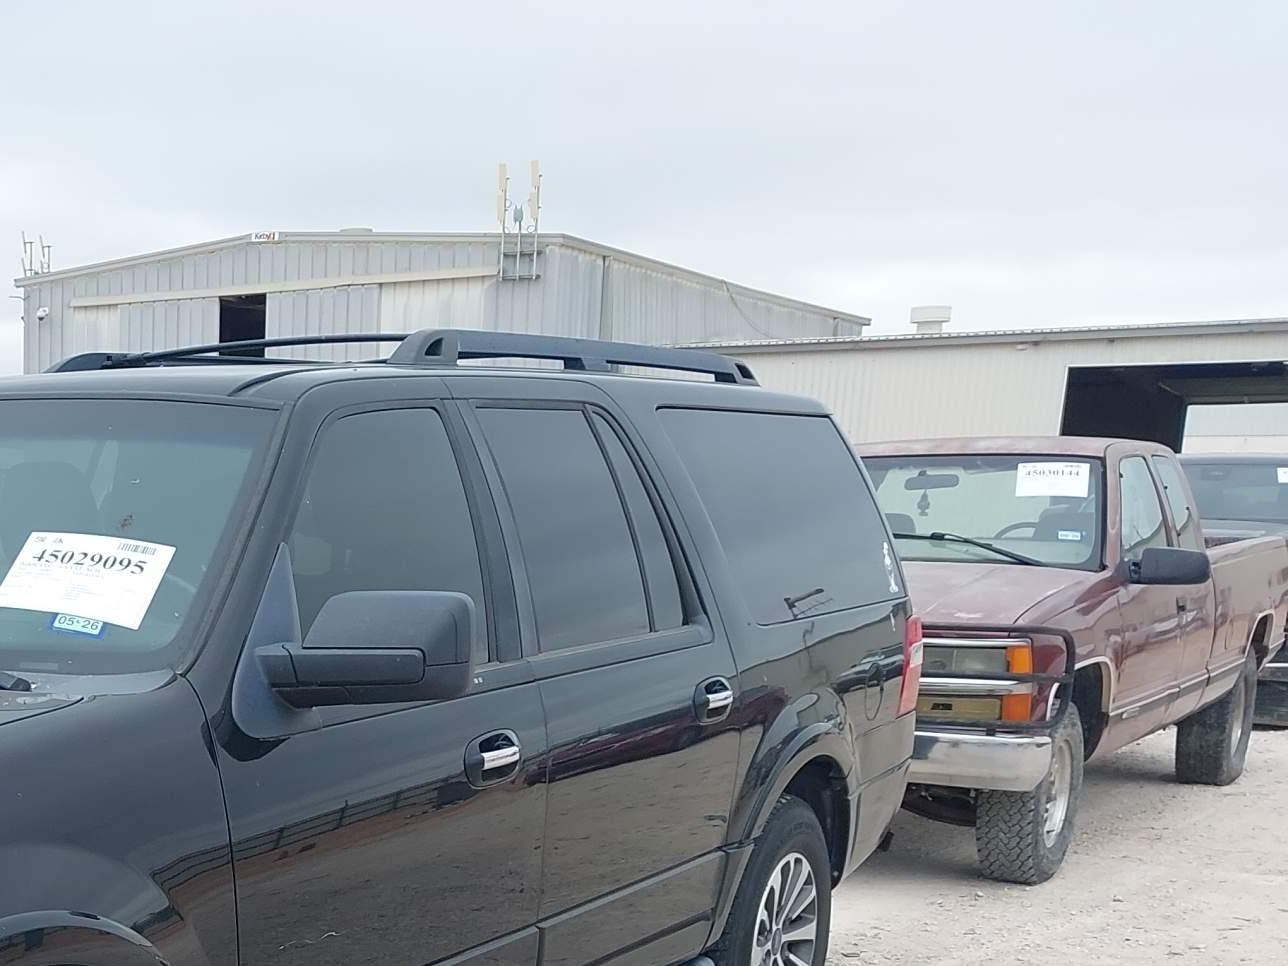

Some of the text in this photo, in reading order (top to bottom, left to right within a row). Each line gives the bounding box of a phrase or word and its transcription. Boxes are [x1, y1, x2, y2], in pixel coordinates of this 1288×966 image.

[32, 548, 148, 575] 45029095
[58, 615, 100, 631] 05 26
